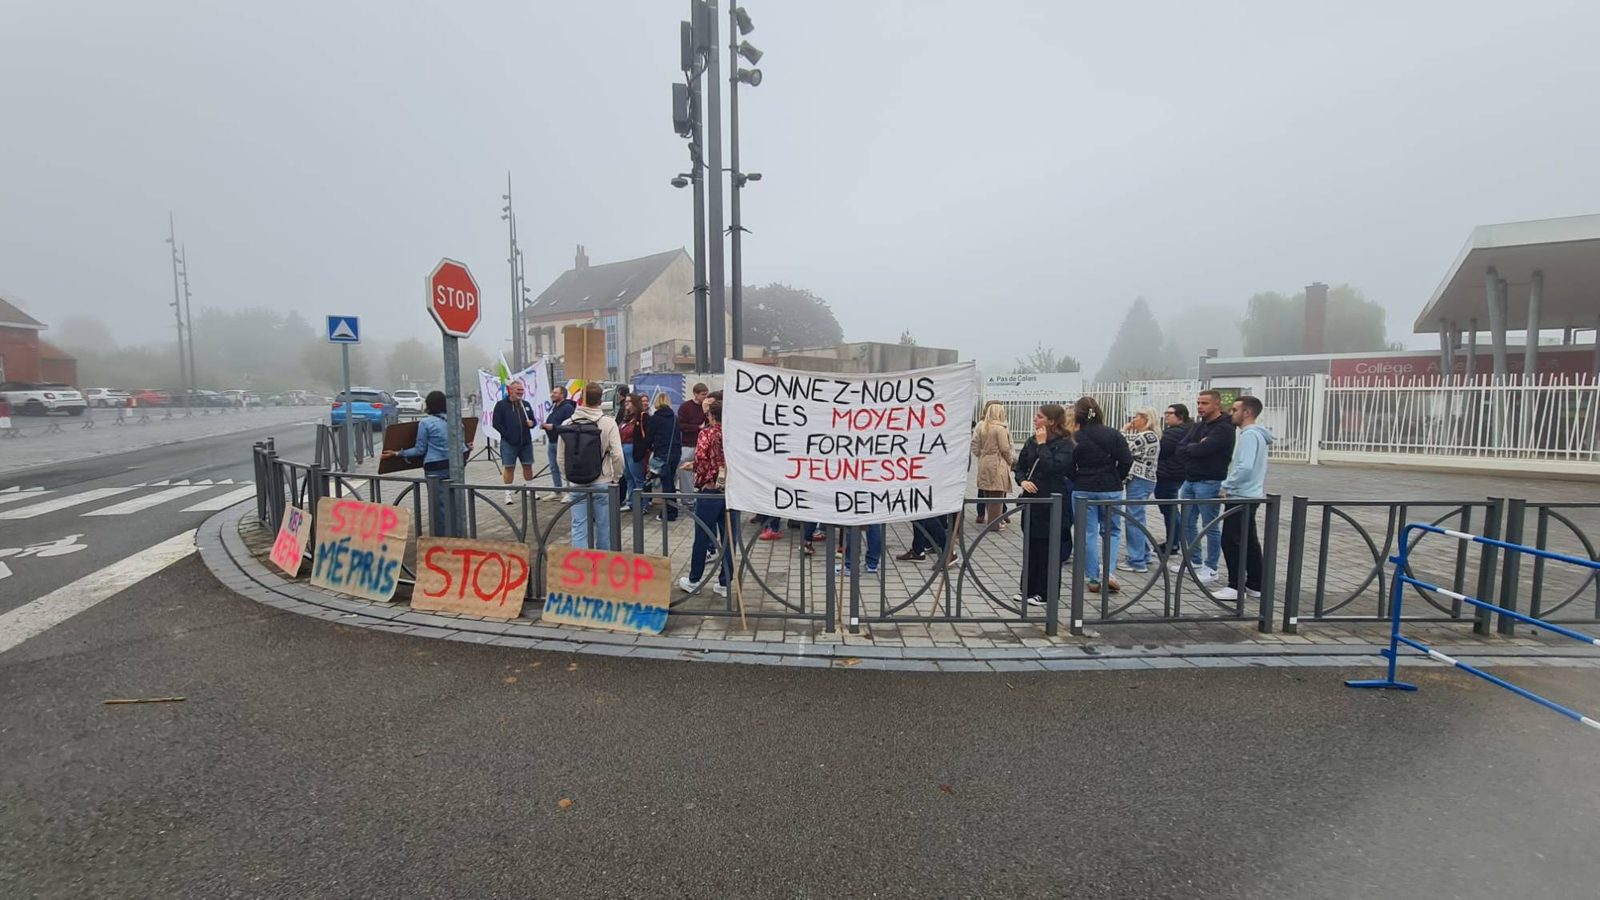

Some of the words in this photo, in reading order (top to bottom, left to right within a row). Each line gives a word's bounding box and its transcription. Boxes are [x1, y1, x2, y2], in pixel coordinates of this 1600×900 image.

[437, 284, 475, 311] STOP
[1355, 360, 1413, 376] Collège
[735, 369, 935, 404] DONNEZ-NOUS
[762, 403, 808, 426] LES
[832, 402, 946, 431] MOYENS
[754, 432, 791, 454] DE
[806, 433, 914, 457] FORMER
[919, 432, 948, 455] LA
[785, 456, 929, 482] JEUNESSE
[774, 487, 813, 510] DE
[835, 485, 933, 515] DEMAIN
[330, 501, 398, 542] STOP
[423, 546, 528, 607] STOP
[561, 550, 656, 595] STOP
